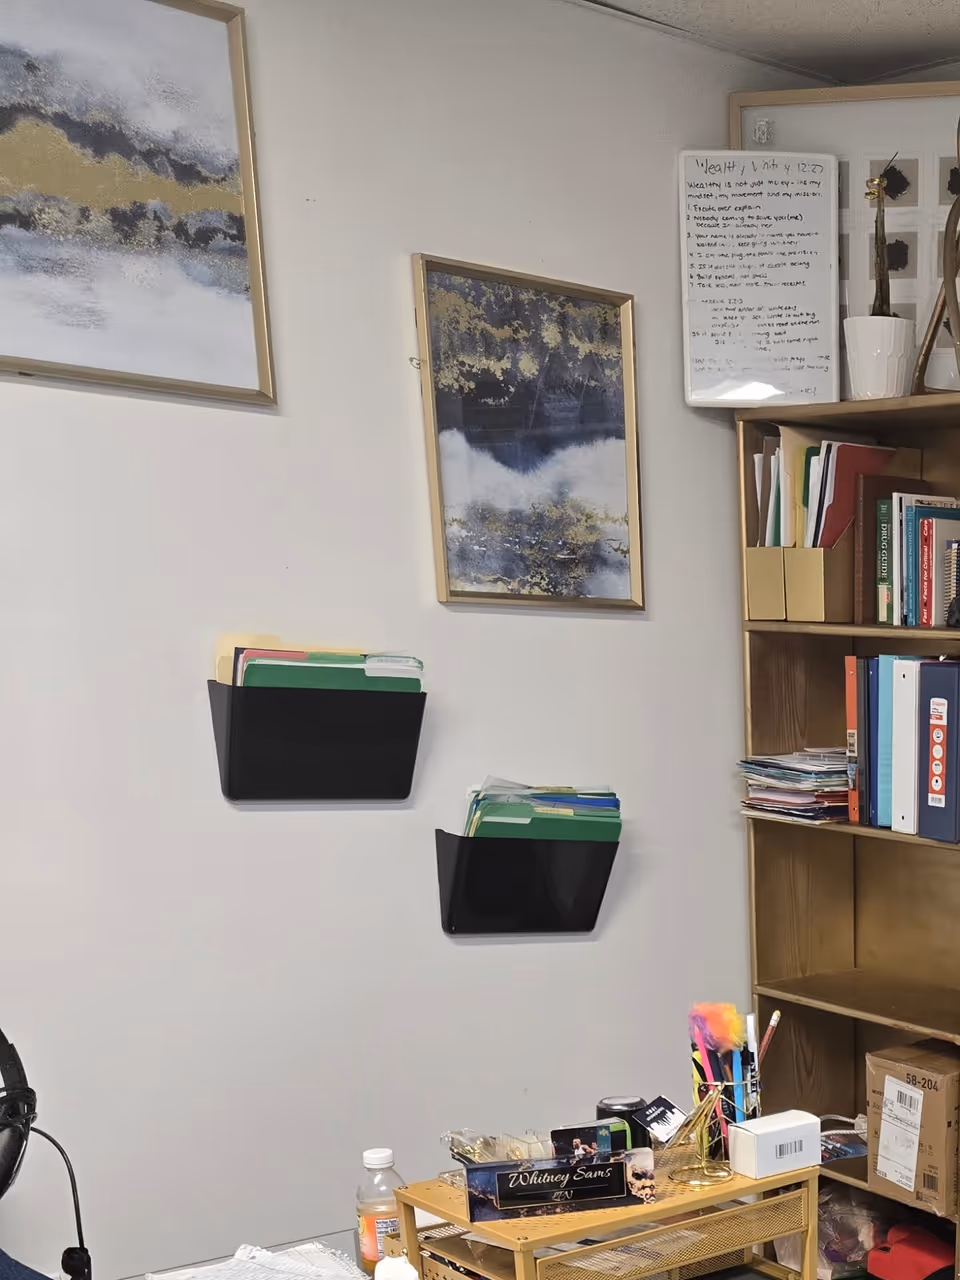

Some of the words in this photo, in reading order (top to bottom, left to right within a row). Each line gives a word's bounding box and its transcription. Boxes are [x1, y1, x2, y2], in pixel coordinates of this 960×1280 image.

[906, 1073, 939, 1092] 58-204
[508, 1171, 571, 1188] Whitney
[572, 1166, 613, 1181] Sams
